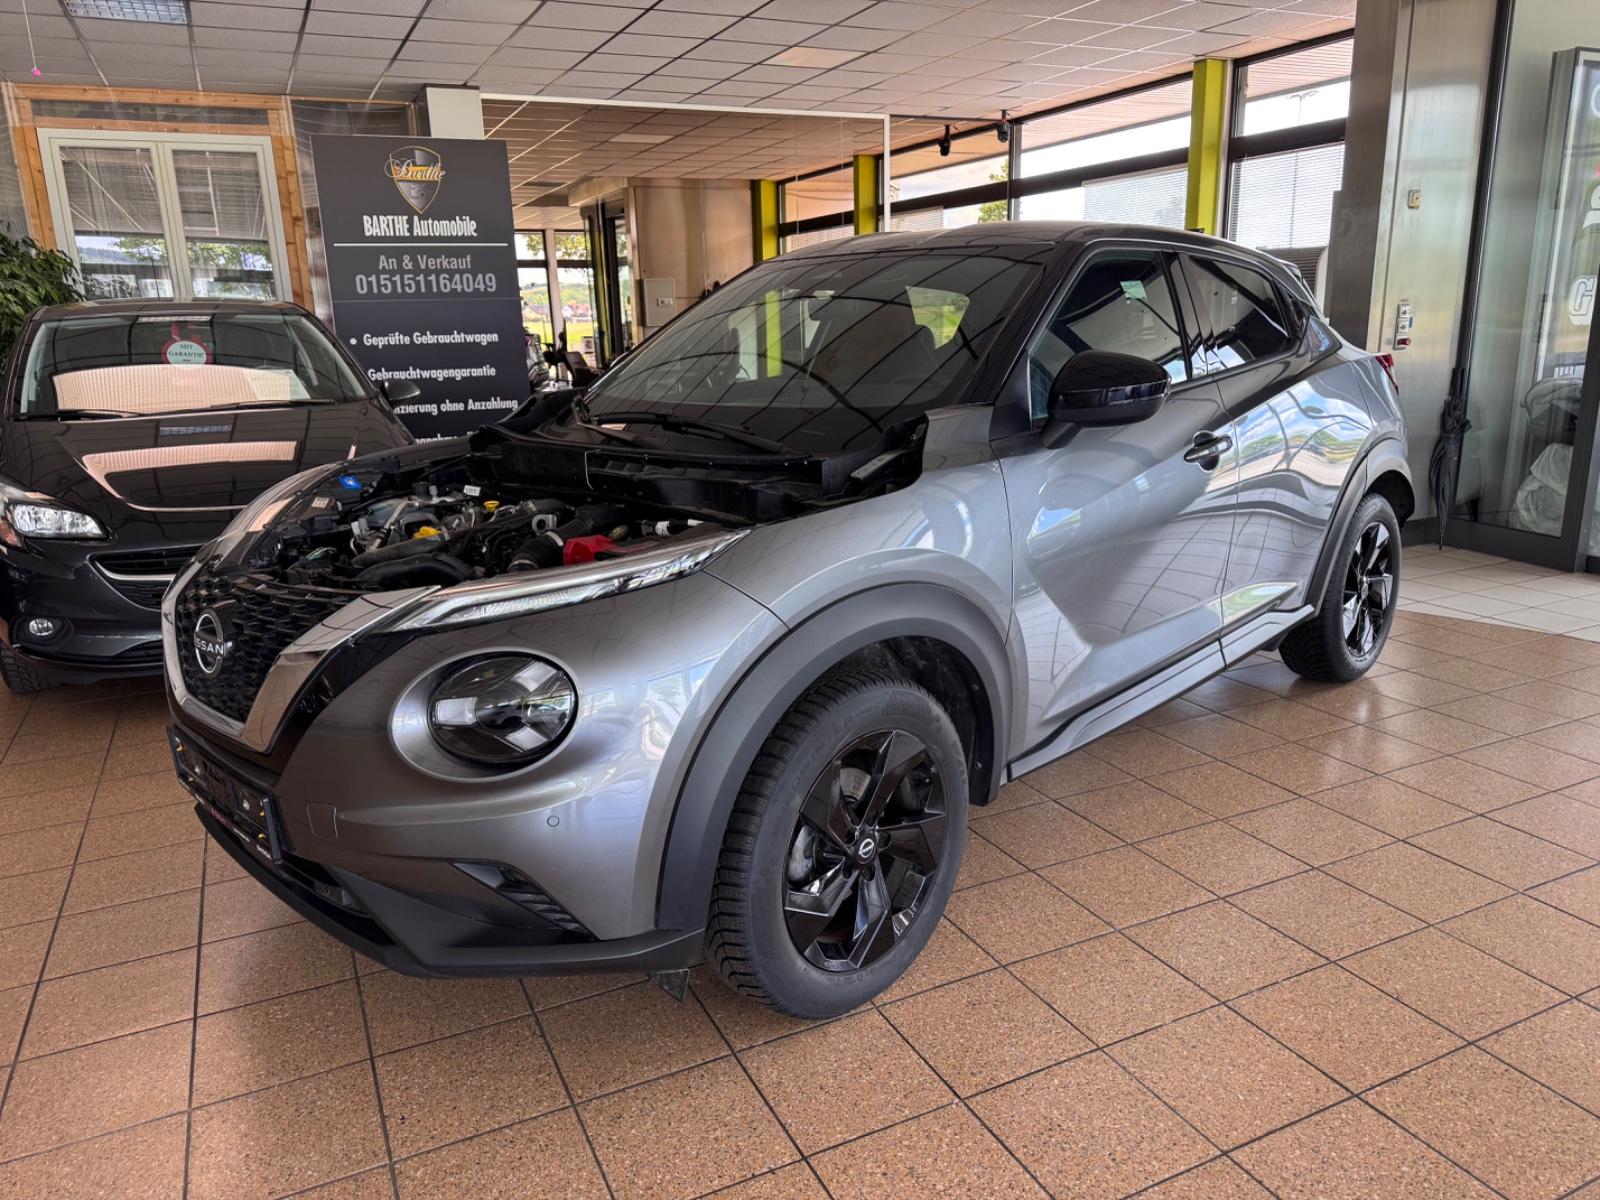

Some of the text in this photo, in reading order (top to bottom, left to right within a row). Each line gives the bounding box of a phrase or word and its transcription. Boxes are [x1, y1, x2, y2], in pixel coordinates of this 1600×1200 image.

[384, 159, 446, 179] Barthe
[362, 215, 478, 237] BARTHE Automobile
[378, 254, 472, 270] An & Verkauf
[355, 273, 497, 294] 015151164049
[363, 330, 499, 348] Geprüfte Gebrauchtwagen
[367, 364, 497, 381] Gebrauchtwagengarantie
[394, 396, 519, 415] nzierung ohne Anzahlung
[195, 638, 224, 654] SSAN
